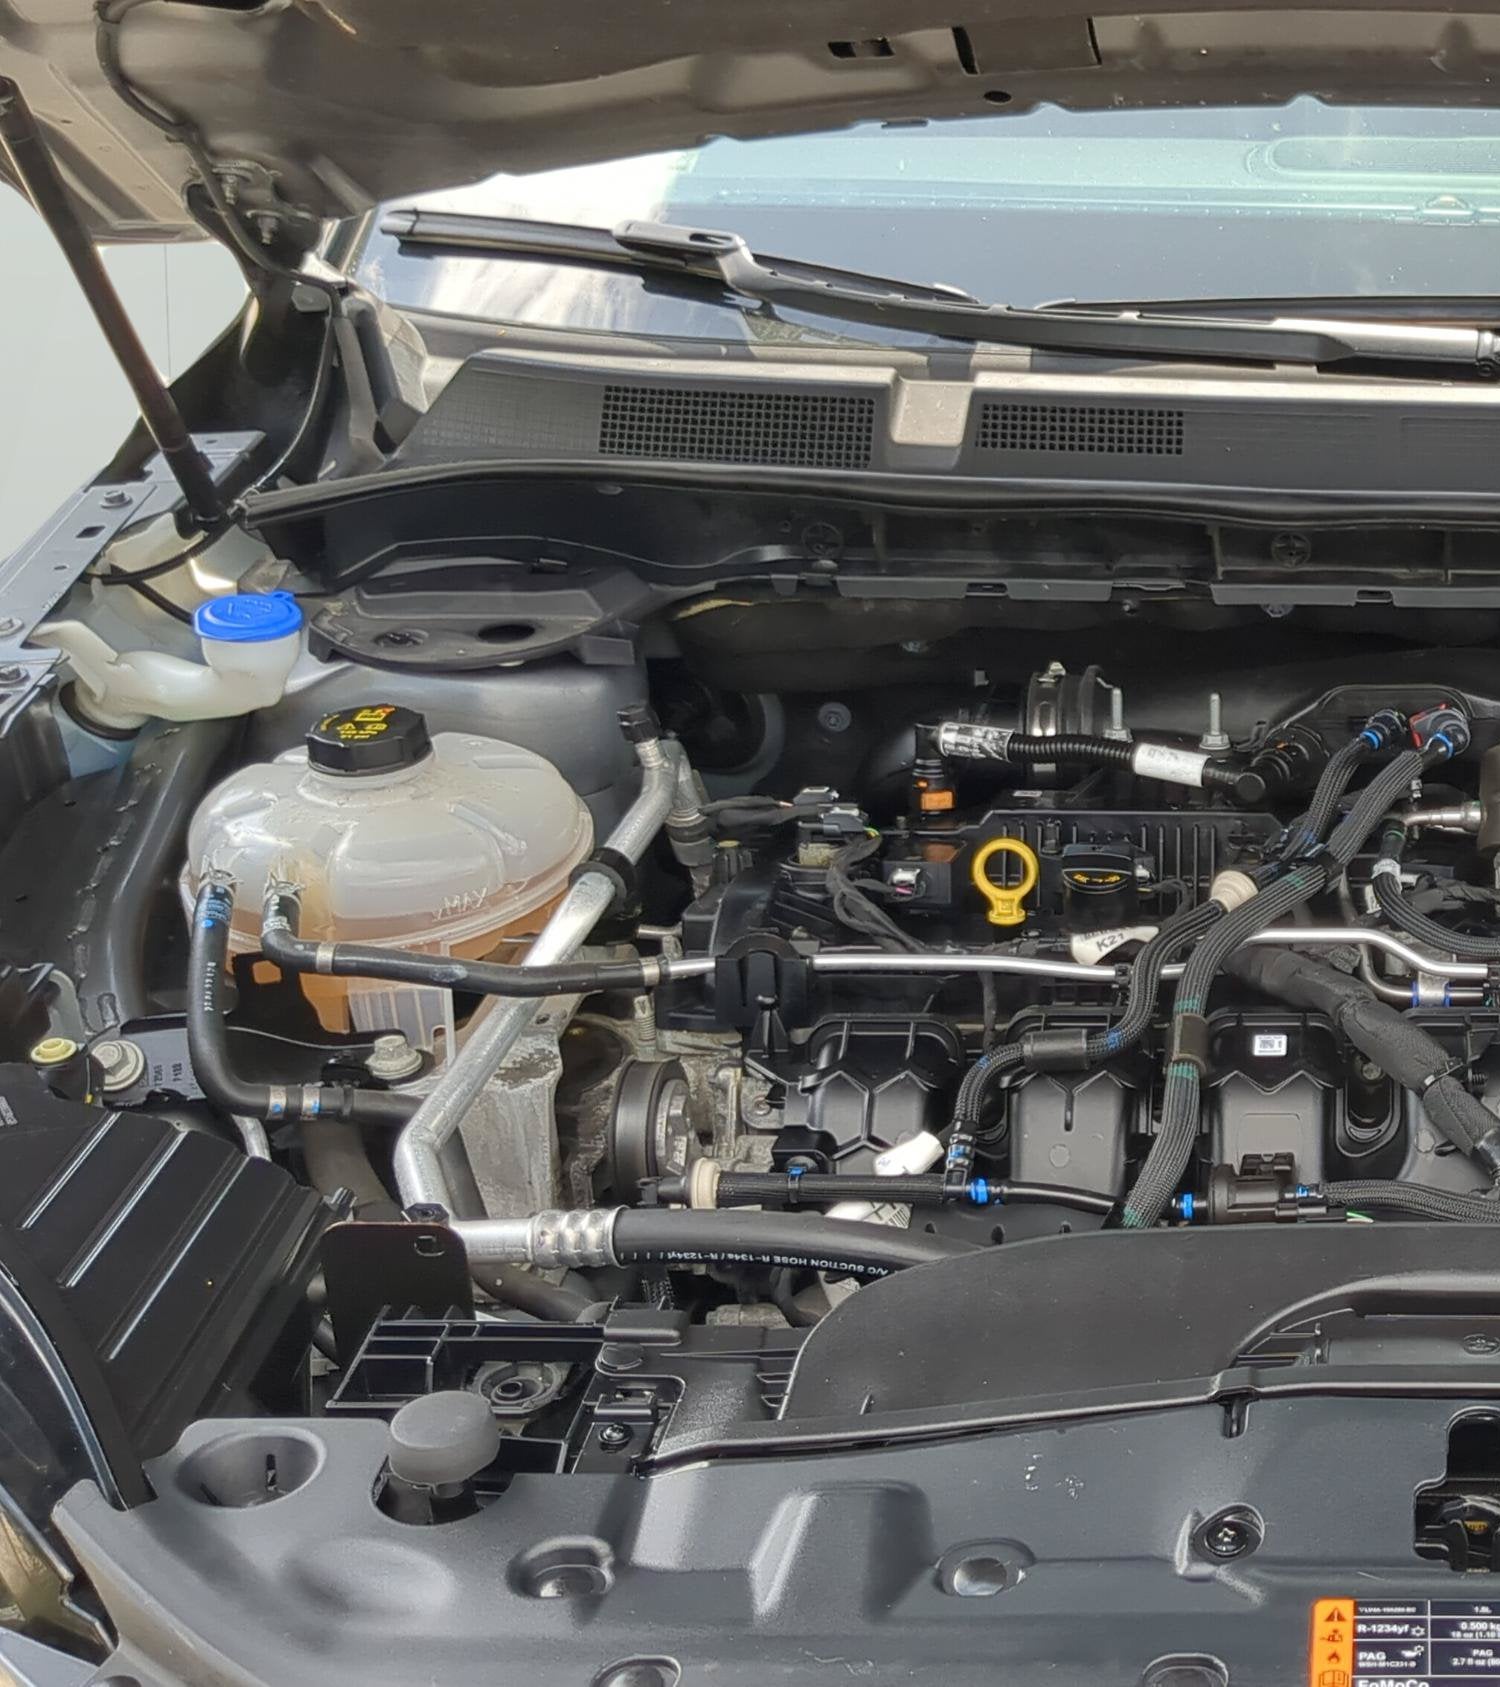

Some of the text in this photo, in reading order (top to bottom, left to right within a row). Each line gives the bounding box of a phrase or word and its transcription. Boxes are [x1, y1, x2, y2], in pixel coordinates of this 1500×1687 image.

[1096, 932, 1125, 952] K21
[773, 1255, 807, 1266] HOSE
[810, 1258, 865, 1272] SUCTION
[1357, 1624, 1410, 1635] R-1234yf
[1461, 1622, 1488, 1631] 0.500
[1359, 1651, 1387, 1661] PAG
[1472, 1649, 1494, 1657] PAG
[1452, 1658, 1466, 1666] 2.7
[1357, 1679, 1430, 1687] FoMoCo
